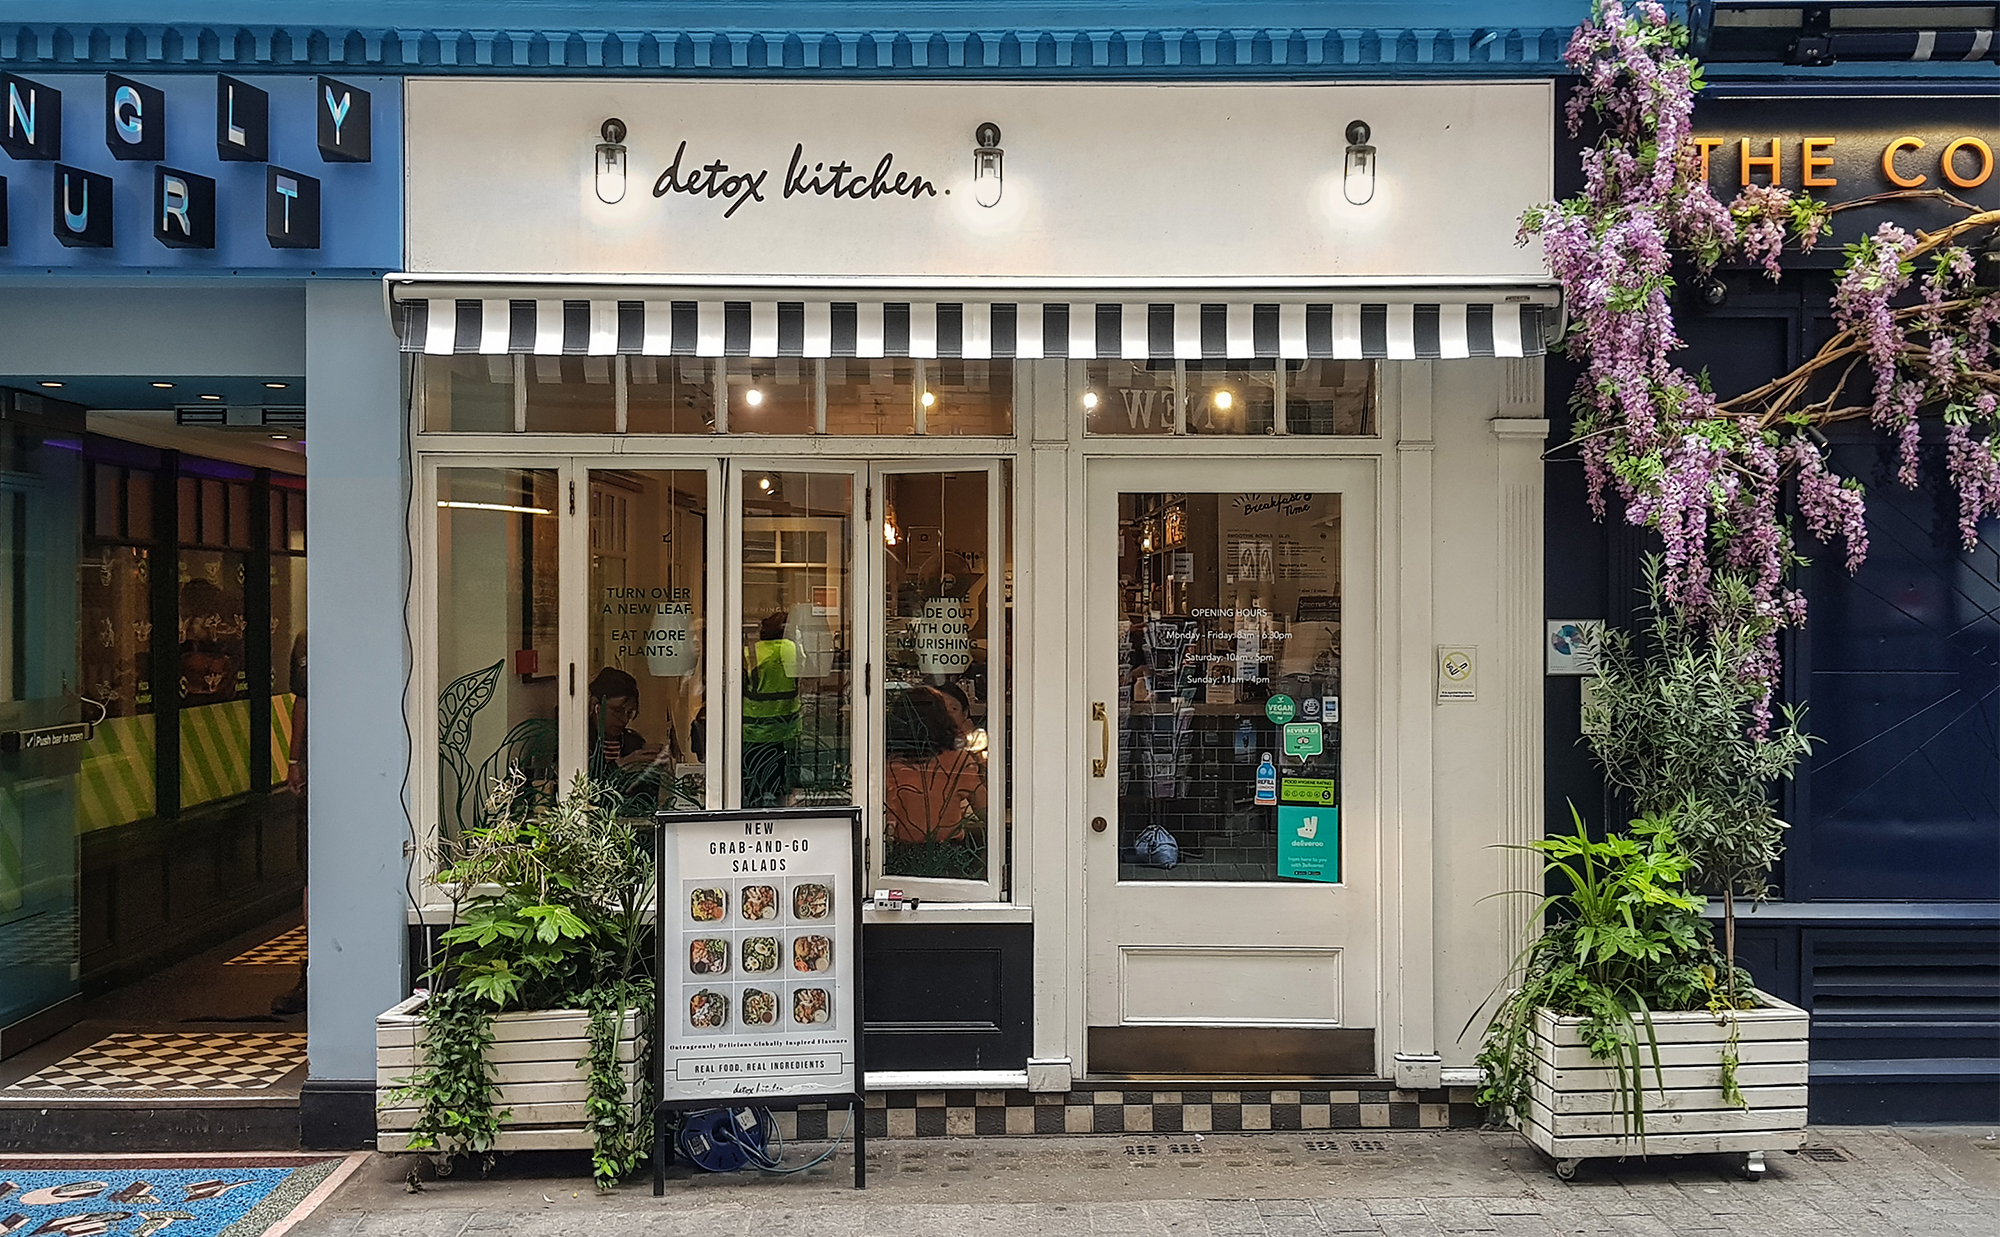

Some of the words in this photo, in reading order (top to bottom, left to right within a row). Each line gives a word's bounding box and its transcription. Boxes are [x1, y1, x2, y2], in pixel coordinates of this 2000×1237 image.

[1692, 137, 1837, 187] THE
[1882, 136, 1994, 188] CO
[652, 140, 768, 219] detox
[1284, 503, 1311, 517] Time
[606, 587, 646, 599] TURN
[651, 587, 691, 599] OVER
[602, 603, 613, 614] A
[618, 603, 651, 614] NEW
[657, 603, 694, 614] LEAF.
[947, 607, 974, 619] OUT
[1191, 608, 1234, 617] OPENING
[1236, 608, 1268, 617] HOURS
[905, 623, 938, 634] WITH
[942, 623, 970, 634] OUR
[611, 630, 637, 641] EAT
[643, 630, 686, 641] MORE
[1166, 631, 1200, 641] Monday
[1207, 630, 1236, 641] Friday:
[1237, 631, 1255, 639] 8am
[619, 645, 678, 657] PLANTS.
[932, 654, 970, 665] FOOD
[1185, 653, 1224, 663] Saturday:
[1226, 653, 1248, 662] 10am
[1255, 653, 1274, 663] 5pm
[1187, 675, 1220, 685] Sunday:
[1222, 675, 1244, 684] 11am
[1251, 675, 1270, 685] 4pm
[1268, 704, 1293, 712] VEGAN
[36, 735, 52, 747] Push
[52, 734, 62, 745] bar
[745, 822, 774, 836] NEW
[709, 839, 809, 855] GRAB-AND-GO
[732, 858, 787, 873] SALADS
[718, 1041, 752, 1049] Delicious
[694, 1065, 715, 1074] REAL
[746, 1062, 767, 1072] REAL
[770, 1060, 825, 1071] INGREDIENTS
[732, 1082, 755, 1096] detox
